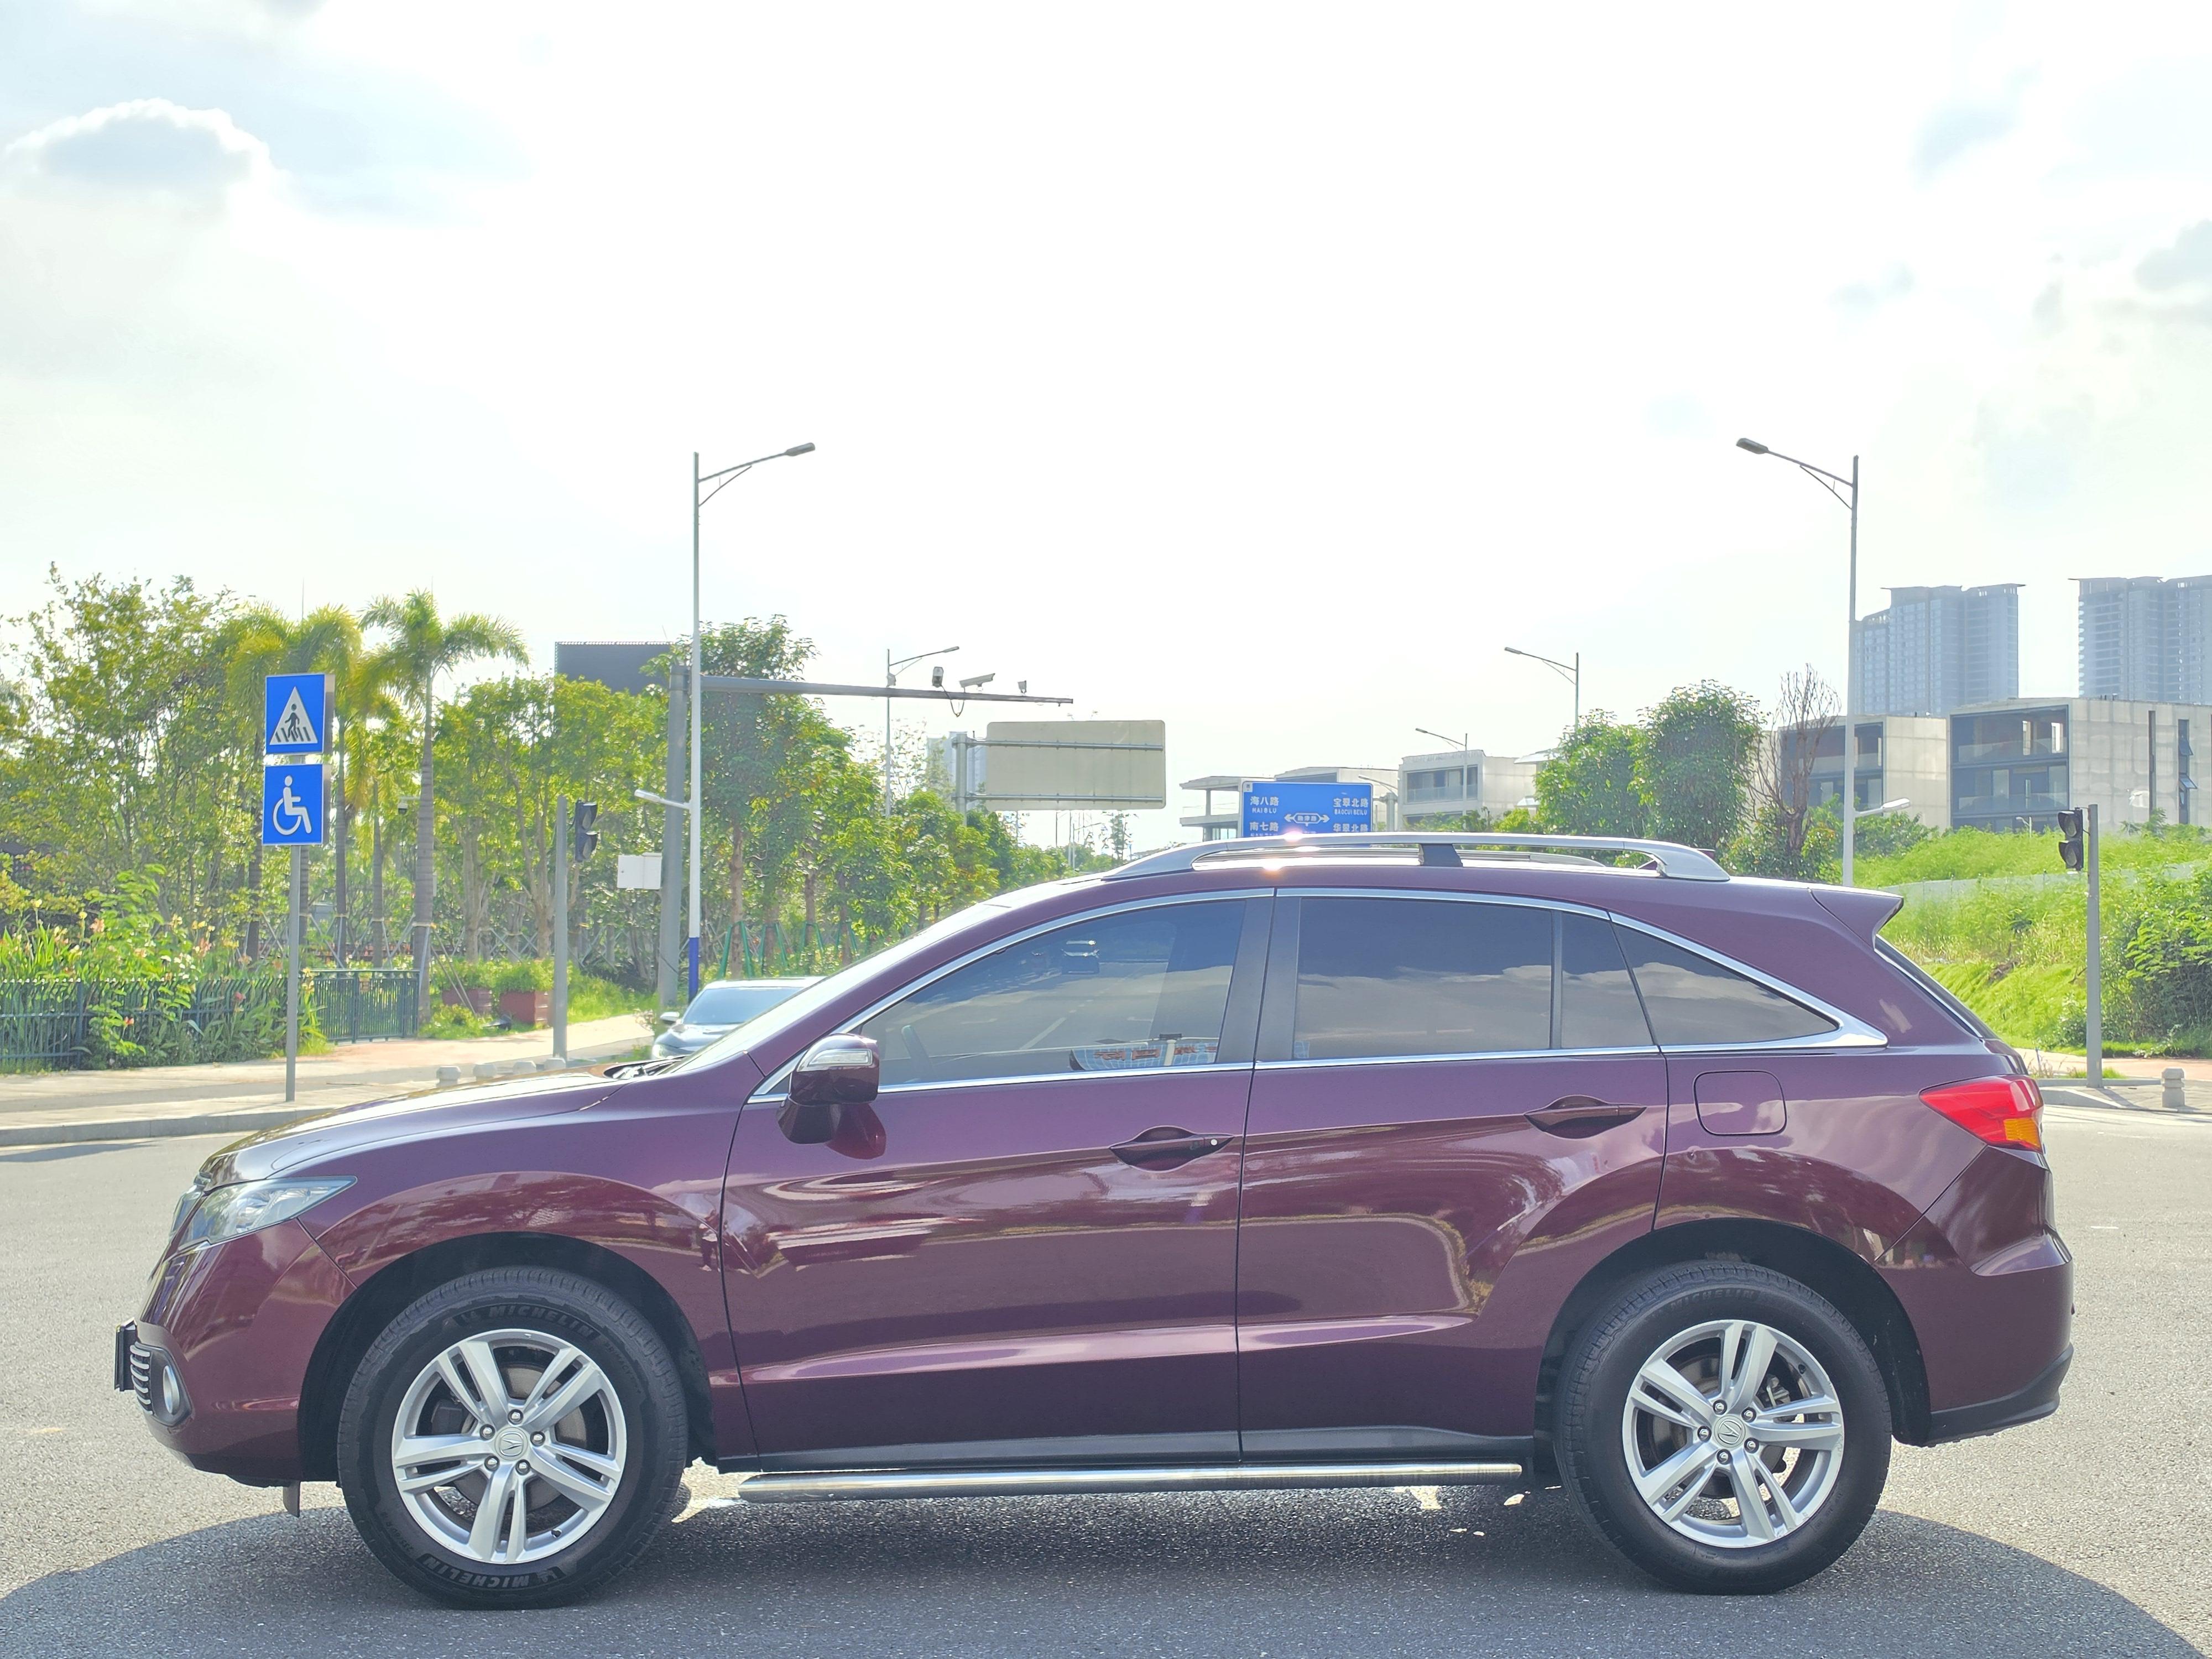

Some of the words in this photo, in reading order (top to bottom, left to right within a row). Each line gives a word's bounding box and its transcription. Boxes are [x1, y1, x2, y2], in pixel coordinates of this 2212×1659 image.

[1250, 796, 1279, 806] 海八路
[1333, 798, 1368, 808] 宝翠北路
[1250, 822, 1279, 832] 南七路
[1333, 823, 1368, 832] 华翠北路
[1670, 1289, 1756, 1309] MICHELIN
[489, 1305, 594, 1337] MICHELIN
[423, 1558, 529, 1588] MICHELIN
